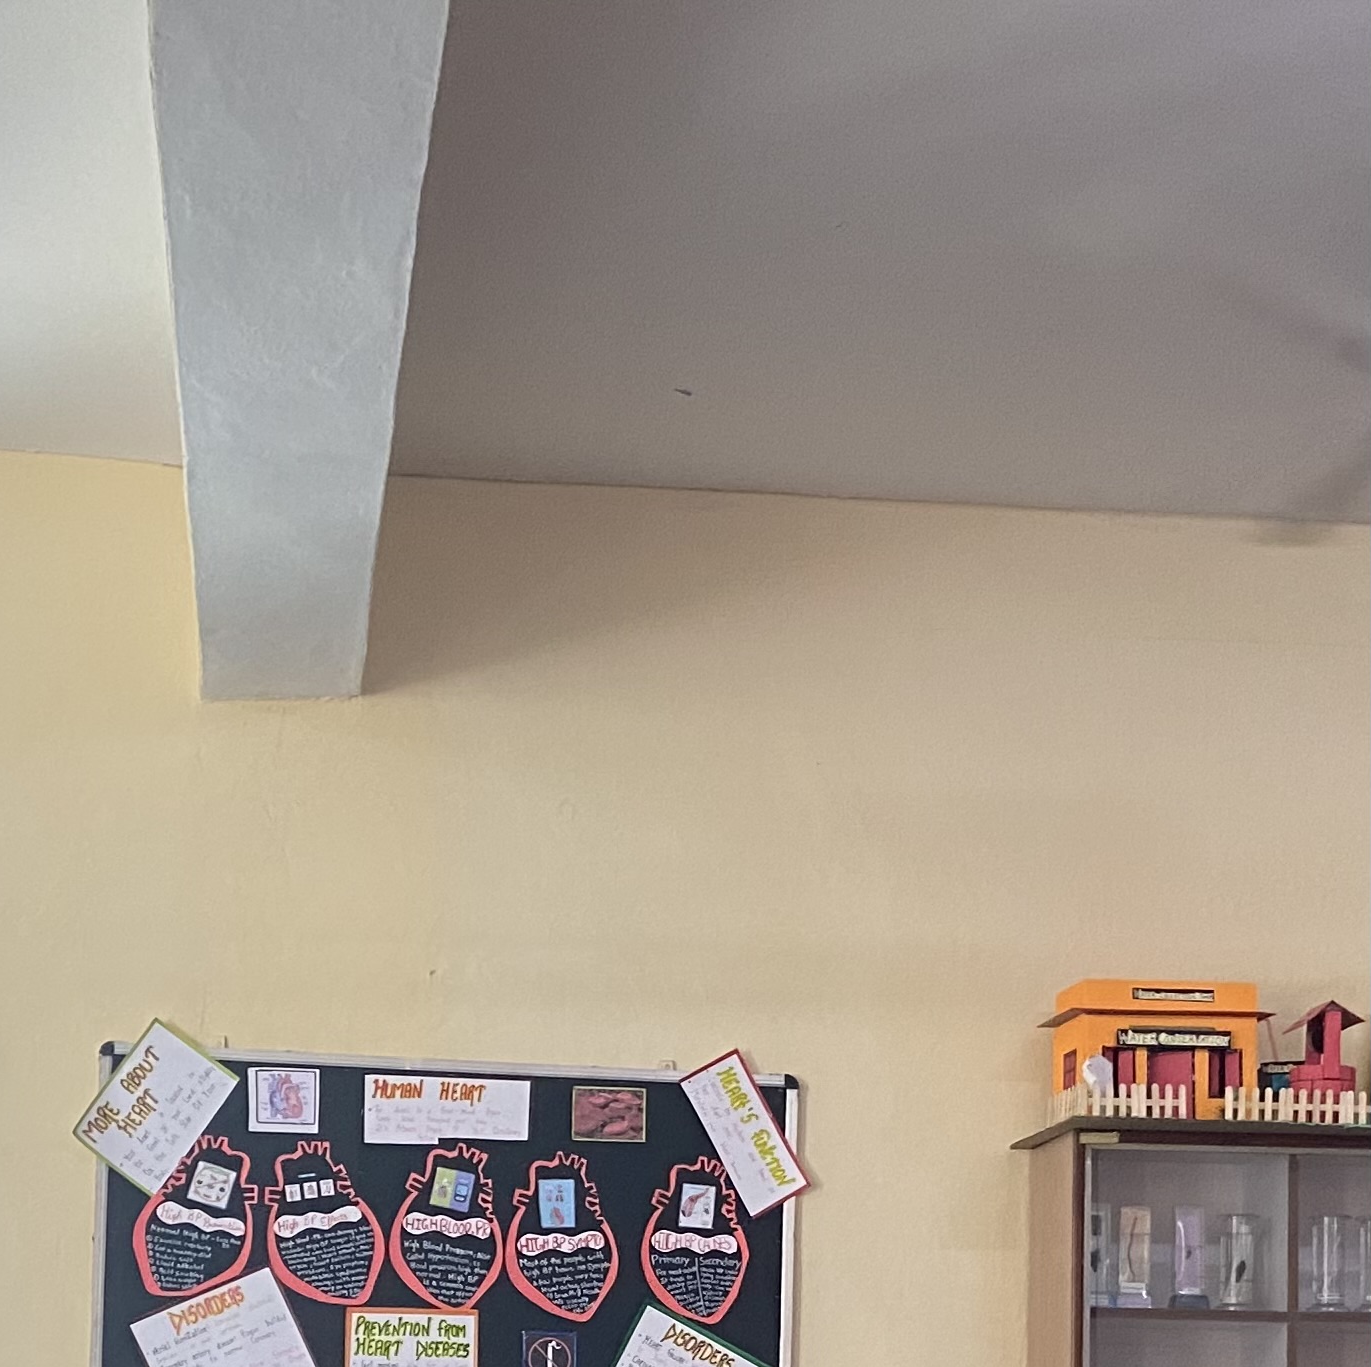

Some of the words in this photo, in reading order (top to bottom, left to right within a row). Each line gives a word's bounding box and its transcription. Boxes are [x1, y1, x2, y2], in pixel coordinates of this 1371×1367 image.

[82, 1101, 120, 1144] MORE
[120, 1045, 160, 1094] ABOUT
[372, 1079, 424, 1099] HUMAN
[439, 1081, 487, 1107] HEART
[116, 1088, 159, 1138] HEART
[277, 1219, 300, 1236] High
[405, 1218, 438, 1231] HIGH
[519, 1237, 549, 1252] HIGH
[651, 1254, 689, 1267] Primary
[699, 1256, 742, 1271] Secondary
[167, 1285, 245, 1336] DISORDERS
[355, 1315, 432, 1338] PREVENTION
[354, 1337, 403, 1360] HEART
[416, 1340, 470, 1360] DISEASES
